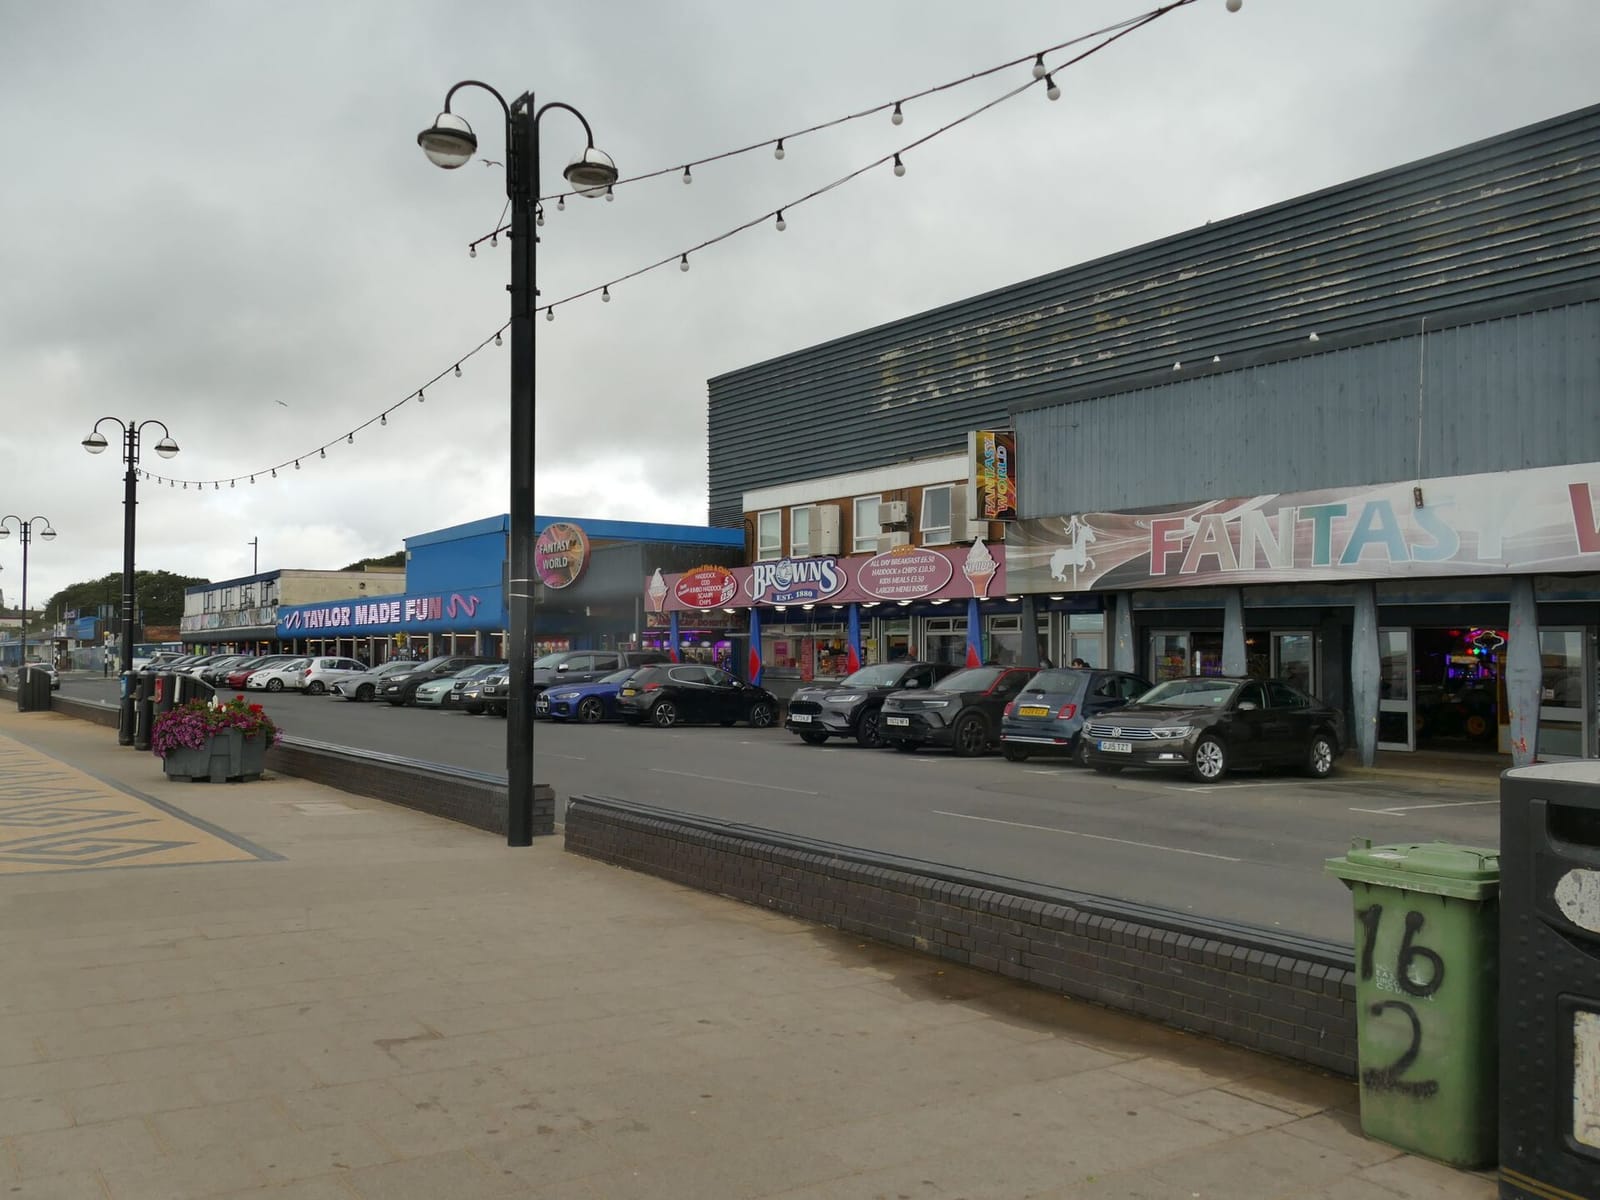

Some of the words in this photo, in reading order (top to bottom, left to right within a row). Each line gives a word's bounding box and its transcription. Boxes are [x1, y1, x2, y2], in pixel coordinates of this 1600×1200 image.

[984, 437, 995, 516] FANTASY
[997, 445, 1008, 511] WORLD
[540, 540, 570, 554] FANTASY
[543, 557, 568, 569] WORLD
[1149, 497, 1509, 577] FANTASY
[752, 558, 838, 601] BROWNS
[776, 593, 793, 601] EST.
[303, 606, 351, 629] TAYLOR
[355, 601, 401, 625] MADE
[405, 596, 443, 621] FUN
[1357, 903, 1444, 996] 16
[1362, 999, 1439, 1098] 2
